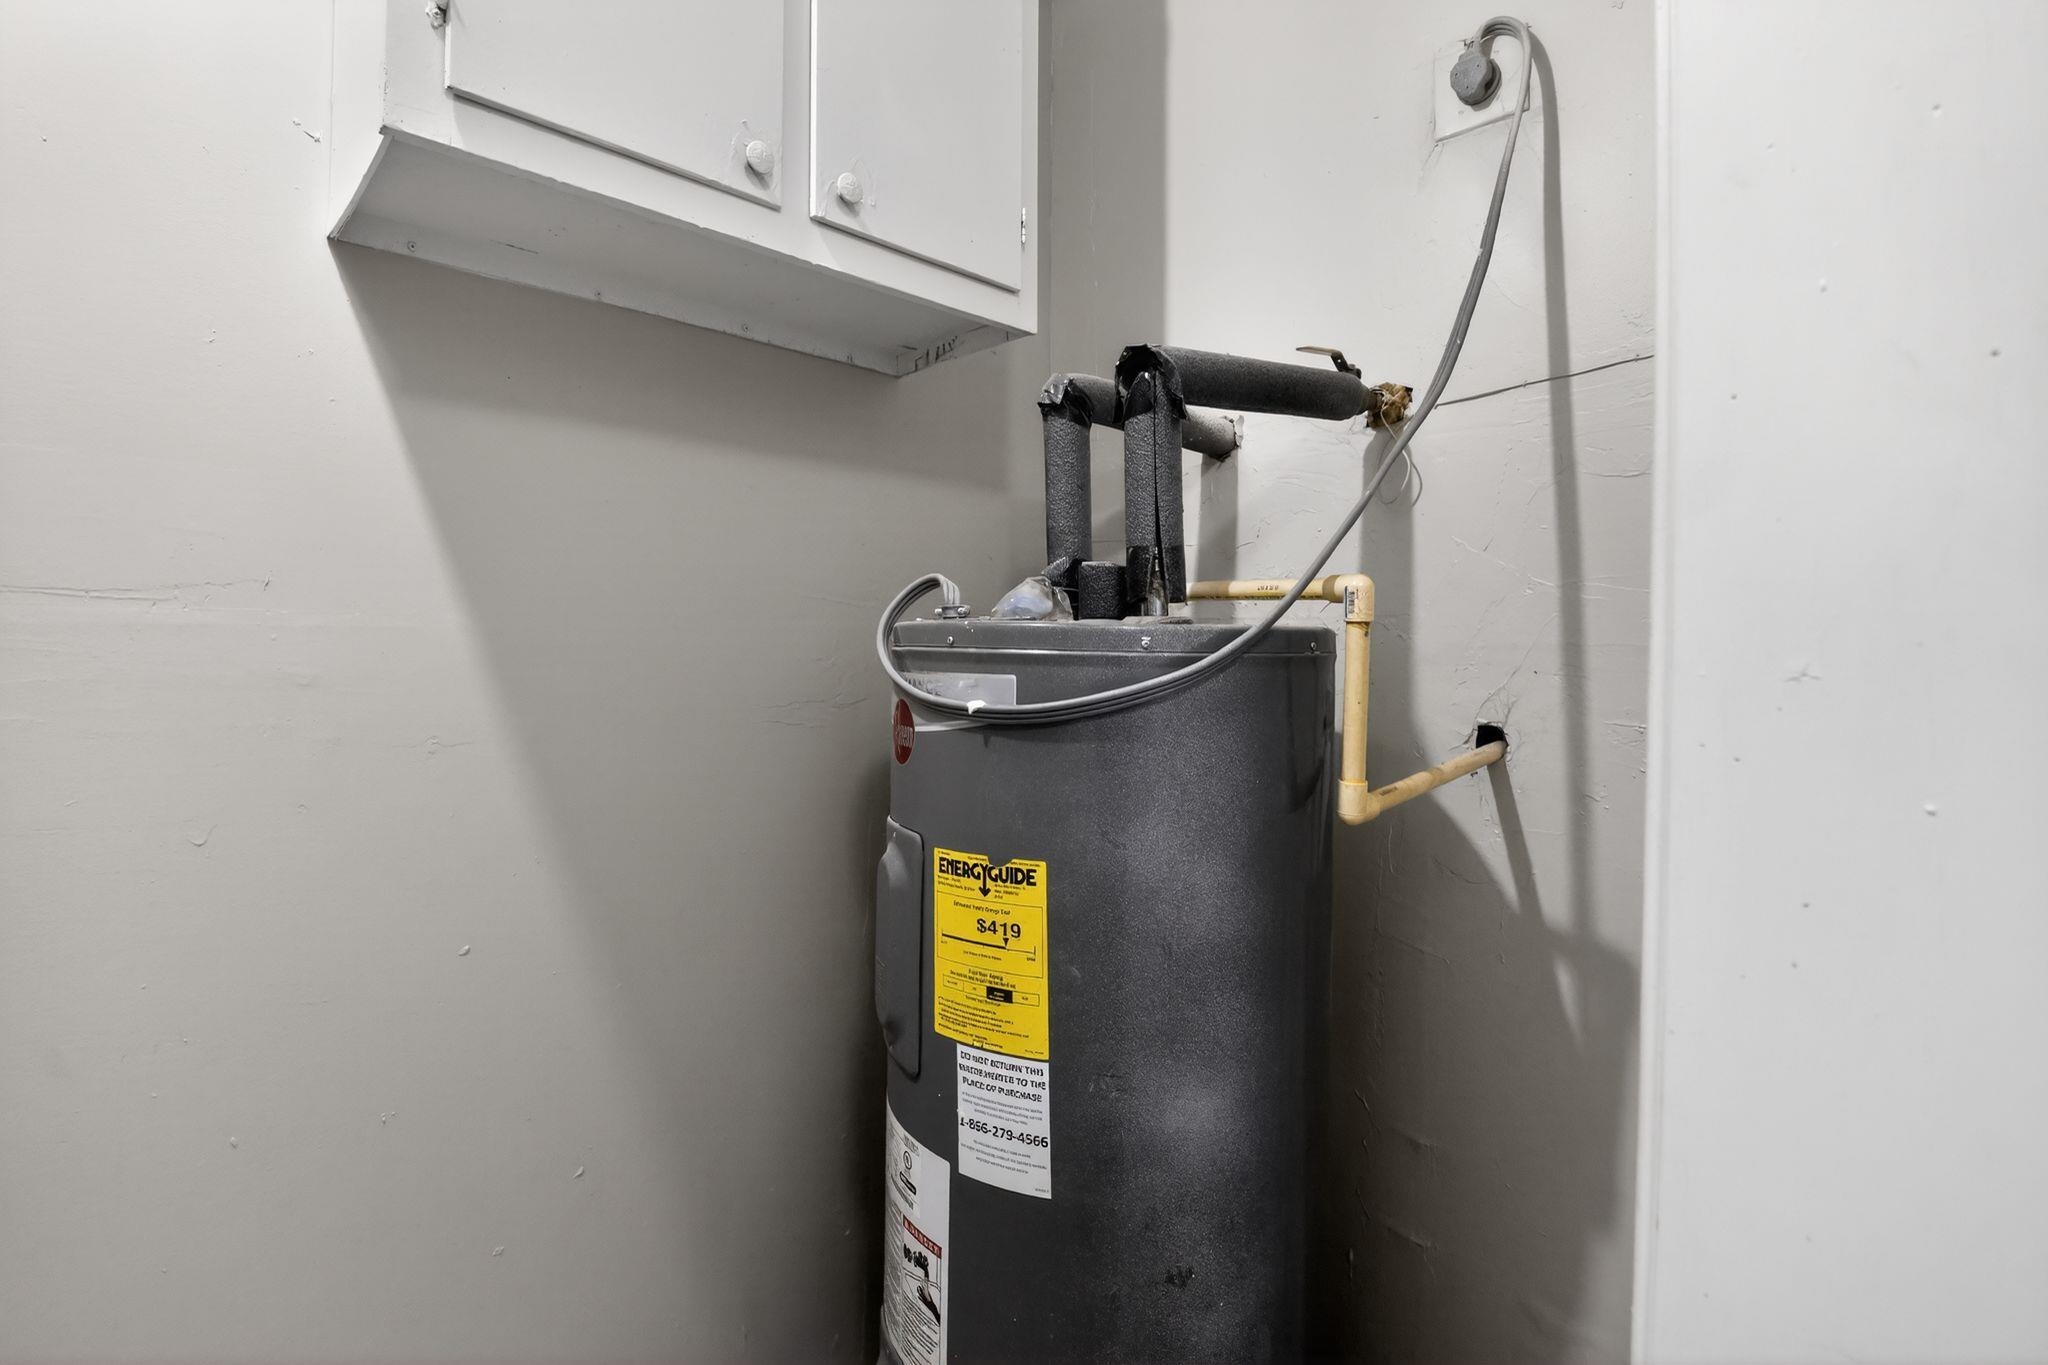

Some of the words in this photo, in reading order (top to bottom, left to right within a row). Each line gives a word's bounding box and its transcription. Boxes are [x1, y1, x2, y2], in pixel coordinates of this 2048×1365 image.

[977, 918, 1021, 938] $419
[1015, 1077, 1028, 1087] TO
[1029, 1080, 1046, 1090] THE
